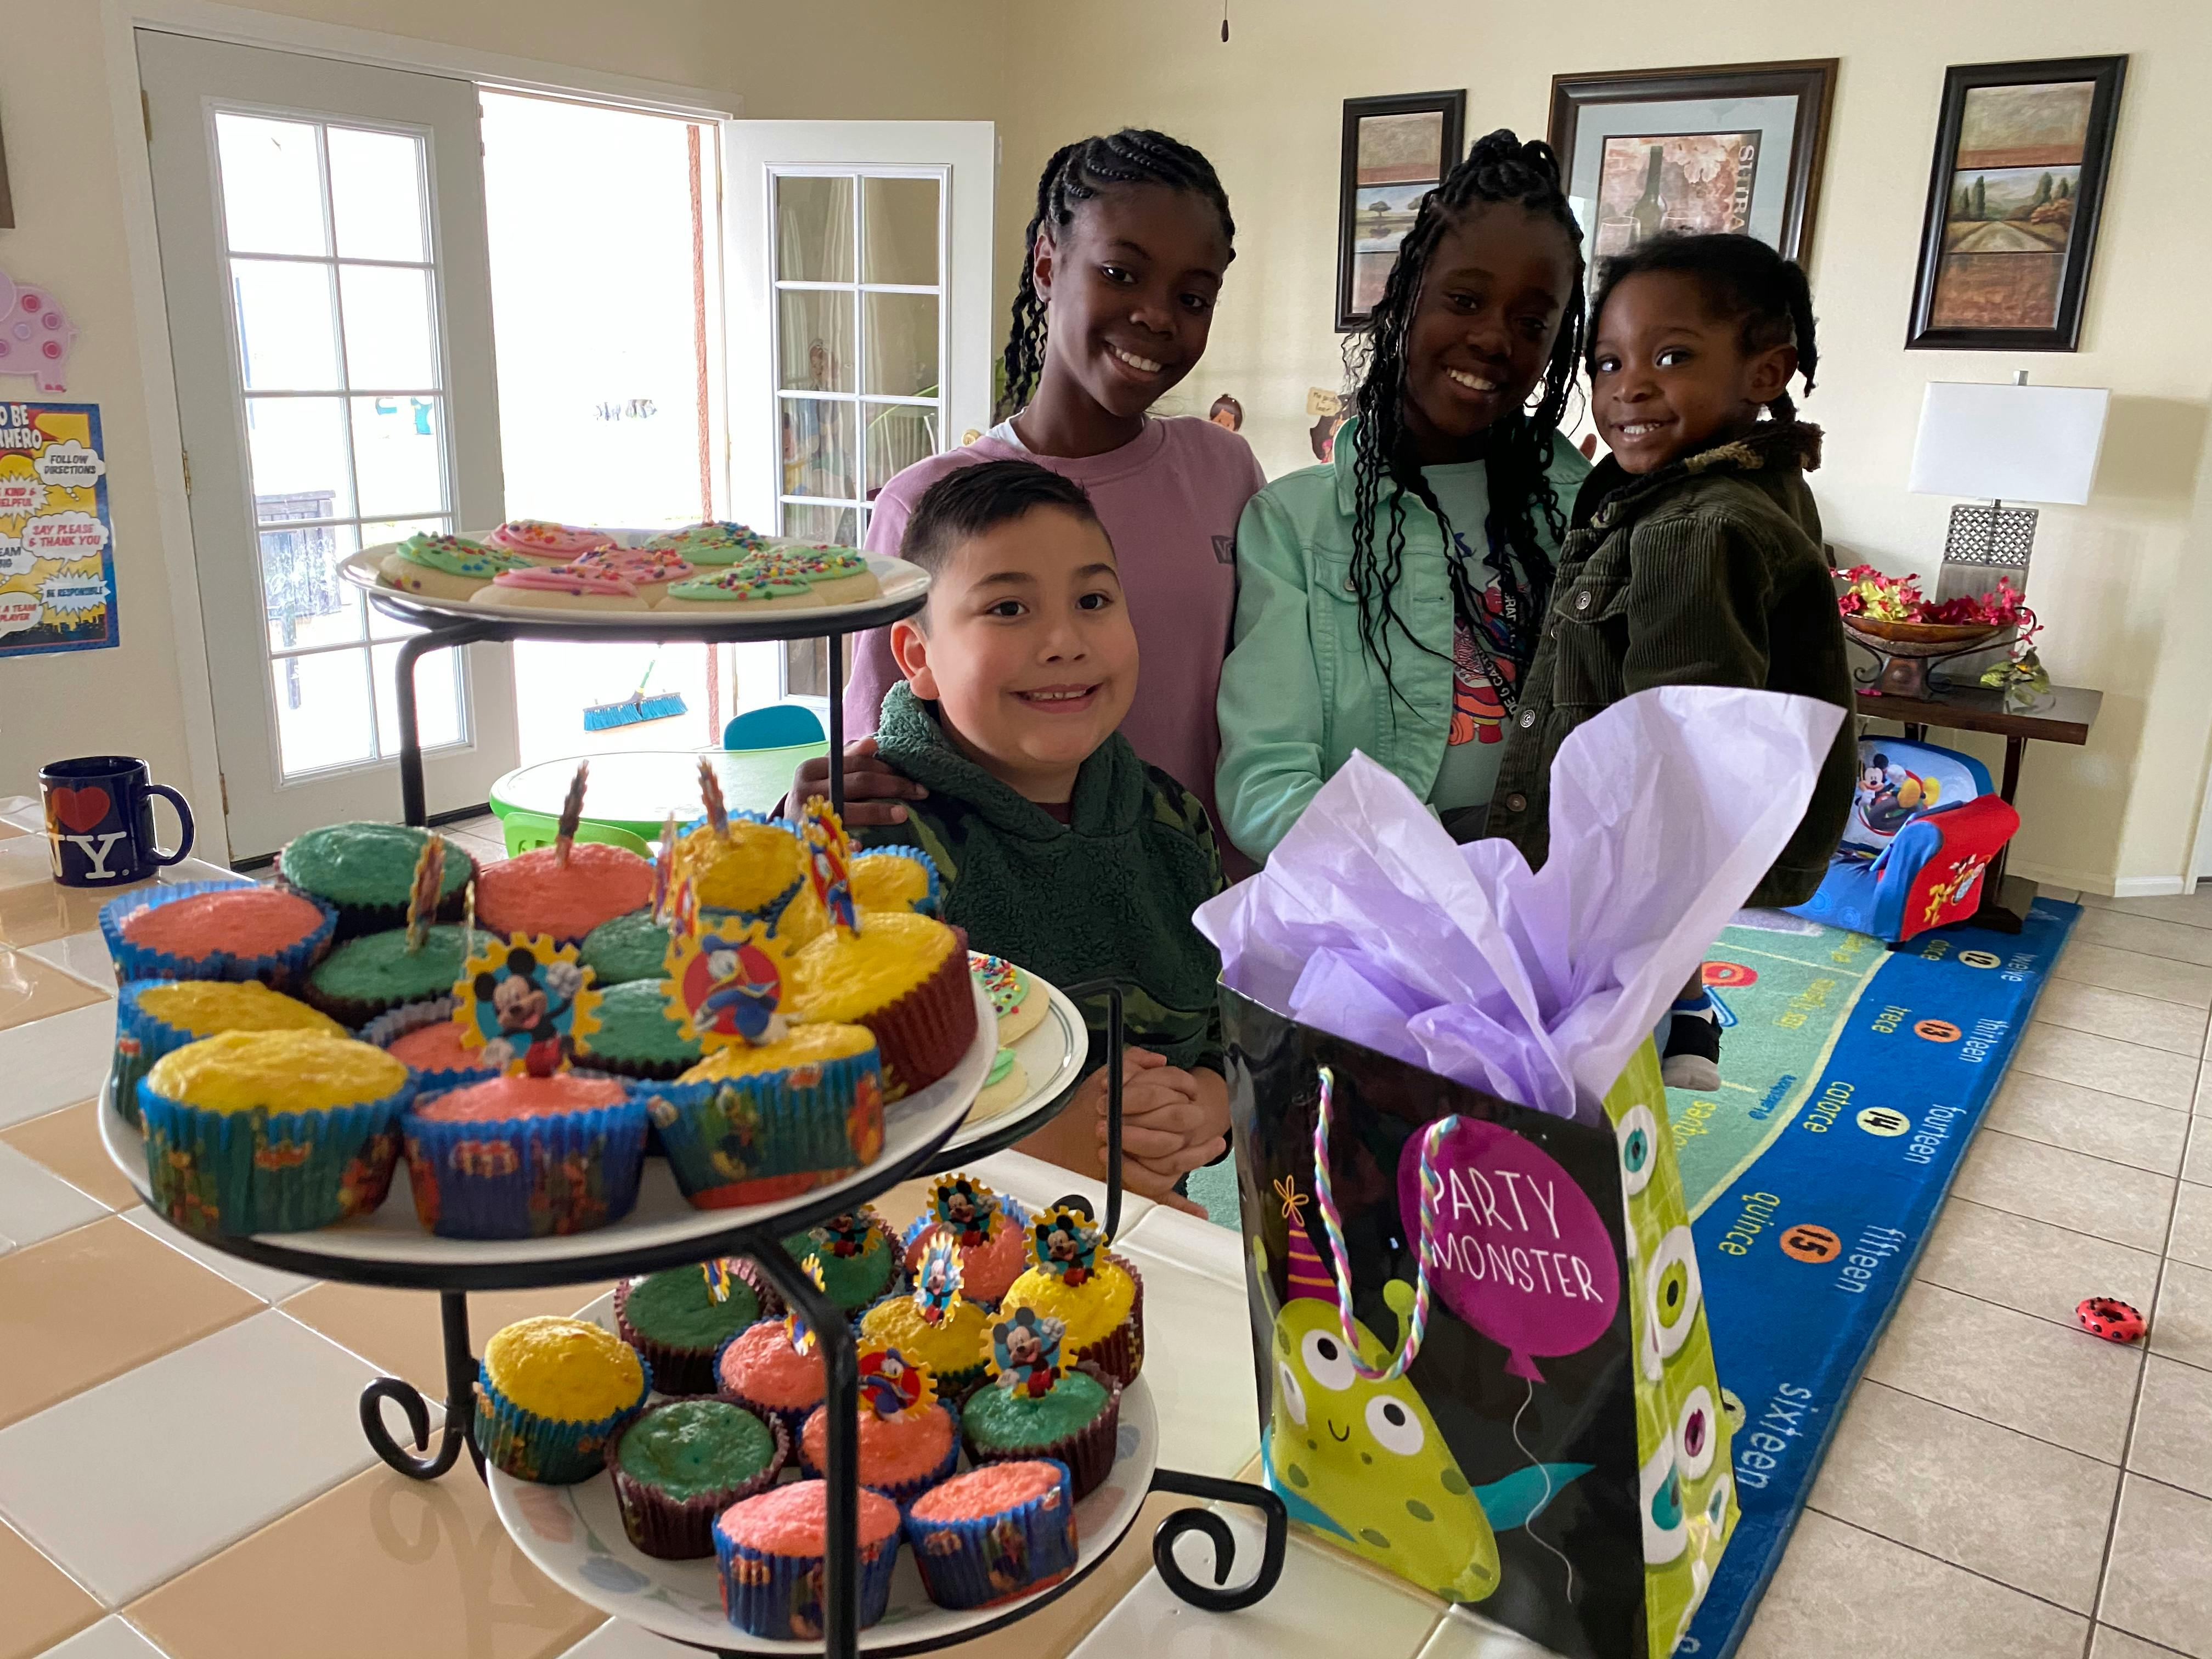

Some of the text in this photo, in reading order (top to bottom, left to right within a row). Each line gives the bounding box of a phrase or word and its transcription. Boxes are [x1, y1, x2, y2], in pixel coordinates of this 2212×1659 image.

[1729, 144, 1755, 232] SHIRA
[10, 405, 29, 427] BE
[44, 465, 97, 475] DIRECTIONS
[50, 455, 89, 464] FOLLOW
[32, 524, 94, 535] SAY PLEASE
[40, 537, 75, 546] THANK
[78, 535, 101, 545] YOU
[13, 604, 37, 613] TEAM
[1965, 952, 1994, 966] 12
[2001, 952, 2039, 982] twelve
[1871, 1005, 1913, 1034] trece
[1921, 1023, 1954, 1038] 13
[1957, 1018, 2011, 1063] thirteen
[1803, 1081, 1855, 1133] catorce
[1863, 1110, 1902, 1131] 14
[1903, 1104, 1967, 1164] fourteen
[1432, 1167, 1560, 1239] PARTY
[1718, 1192, 1781, 1256] quince
[1788, 1228, 1833, 1256] 15
[1431, 1232, 1604, 1303] MONSTER
[1835, 1224, 1907, 1294] fifteen
[1735, 1383, 1819, 1489] sixteen
